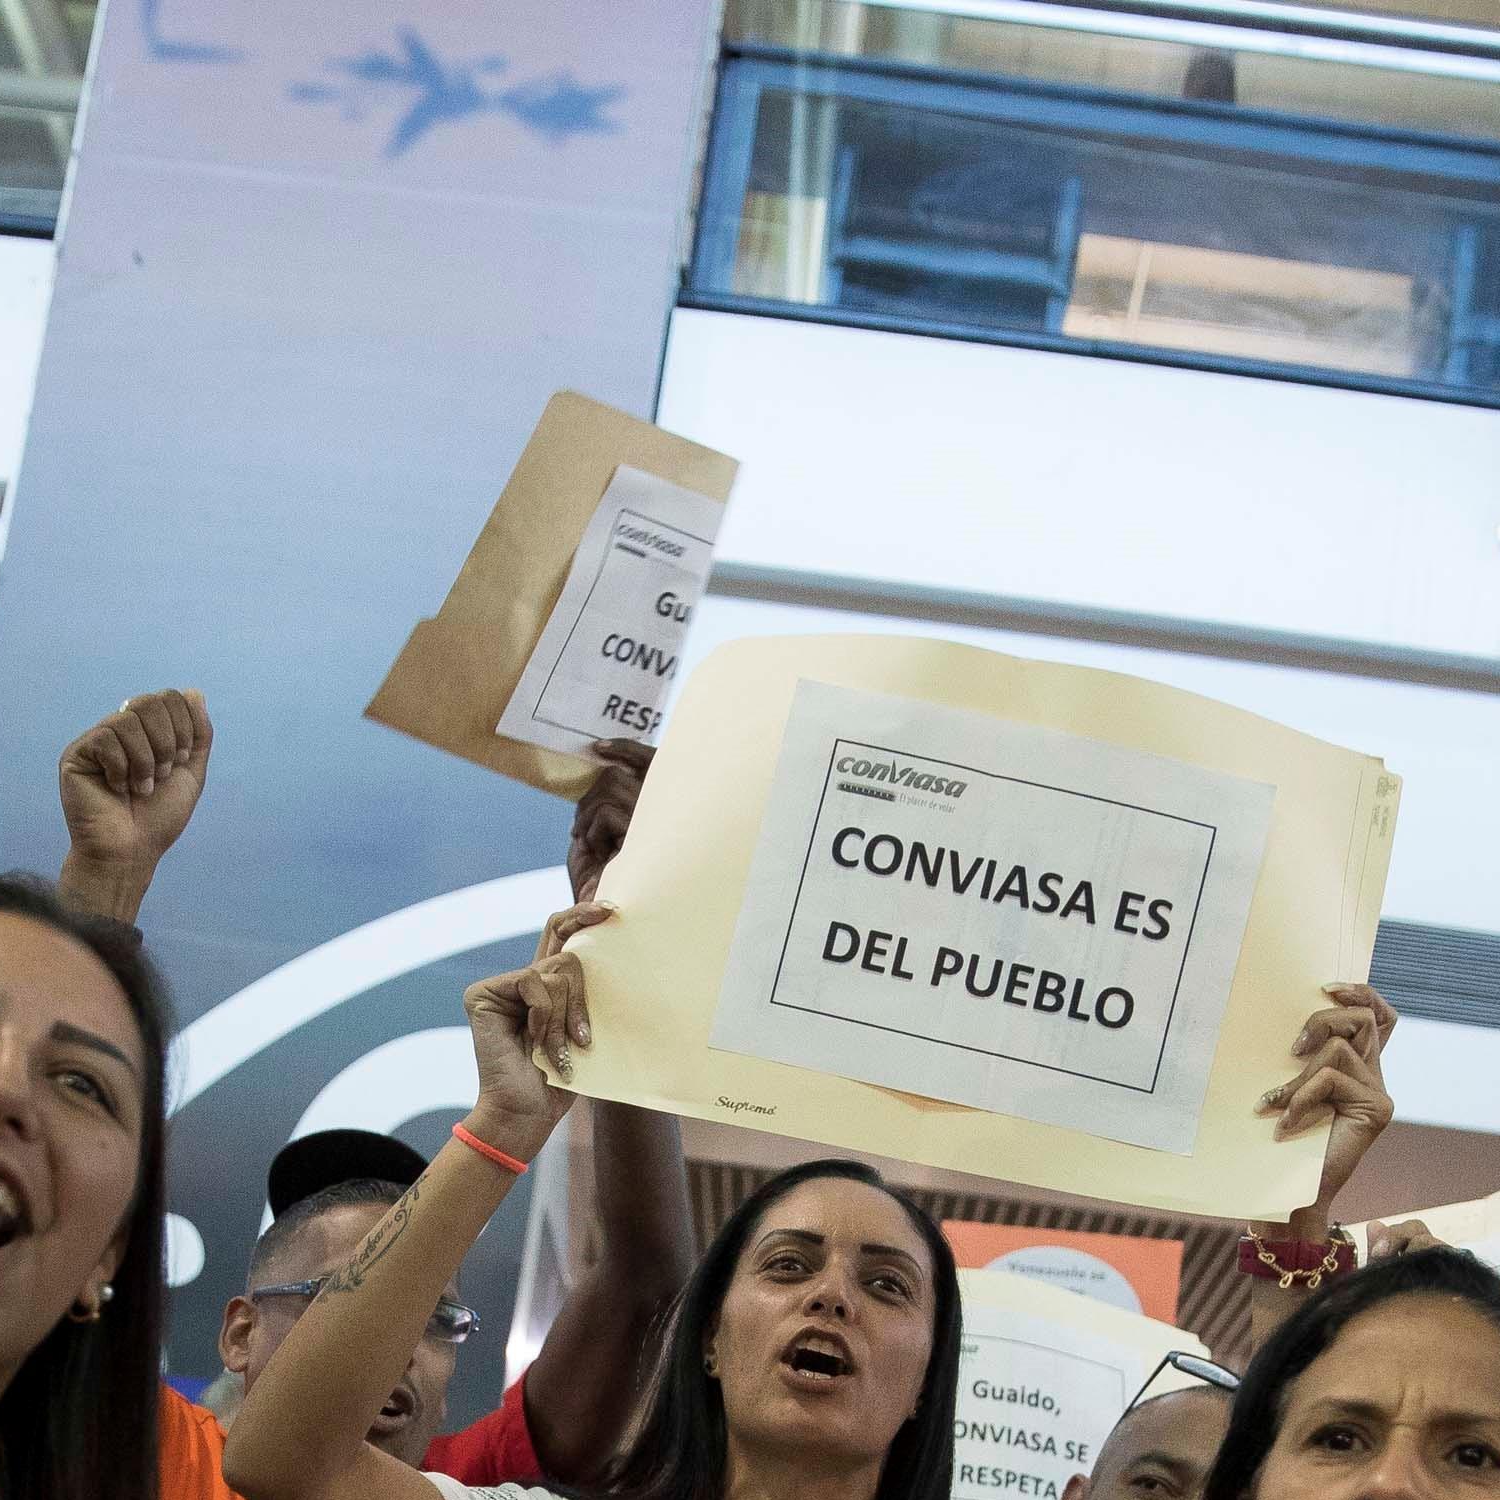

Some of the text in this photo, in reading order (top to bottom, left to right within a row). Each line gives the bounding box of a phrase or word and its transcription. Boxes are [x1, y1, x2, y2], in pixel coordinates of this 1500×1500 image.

[602, 633, 677, 680] CONV
[831, 827, 1174, 940] CONVIASA ES
[822, 920, 1135, 1029] DEL PUEBLO
[954, 1420, 1090, 1463] ONVIASA SE
[960, 1463, 1059, 1500] RESPETA
